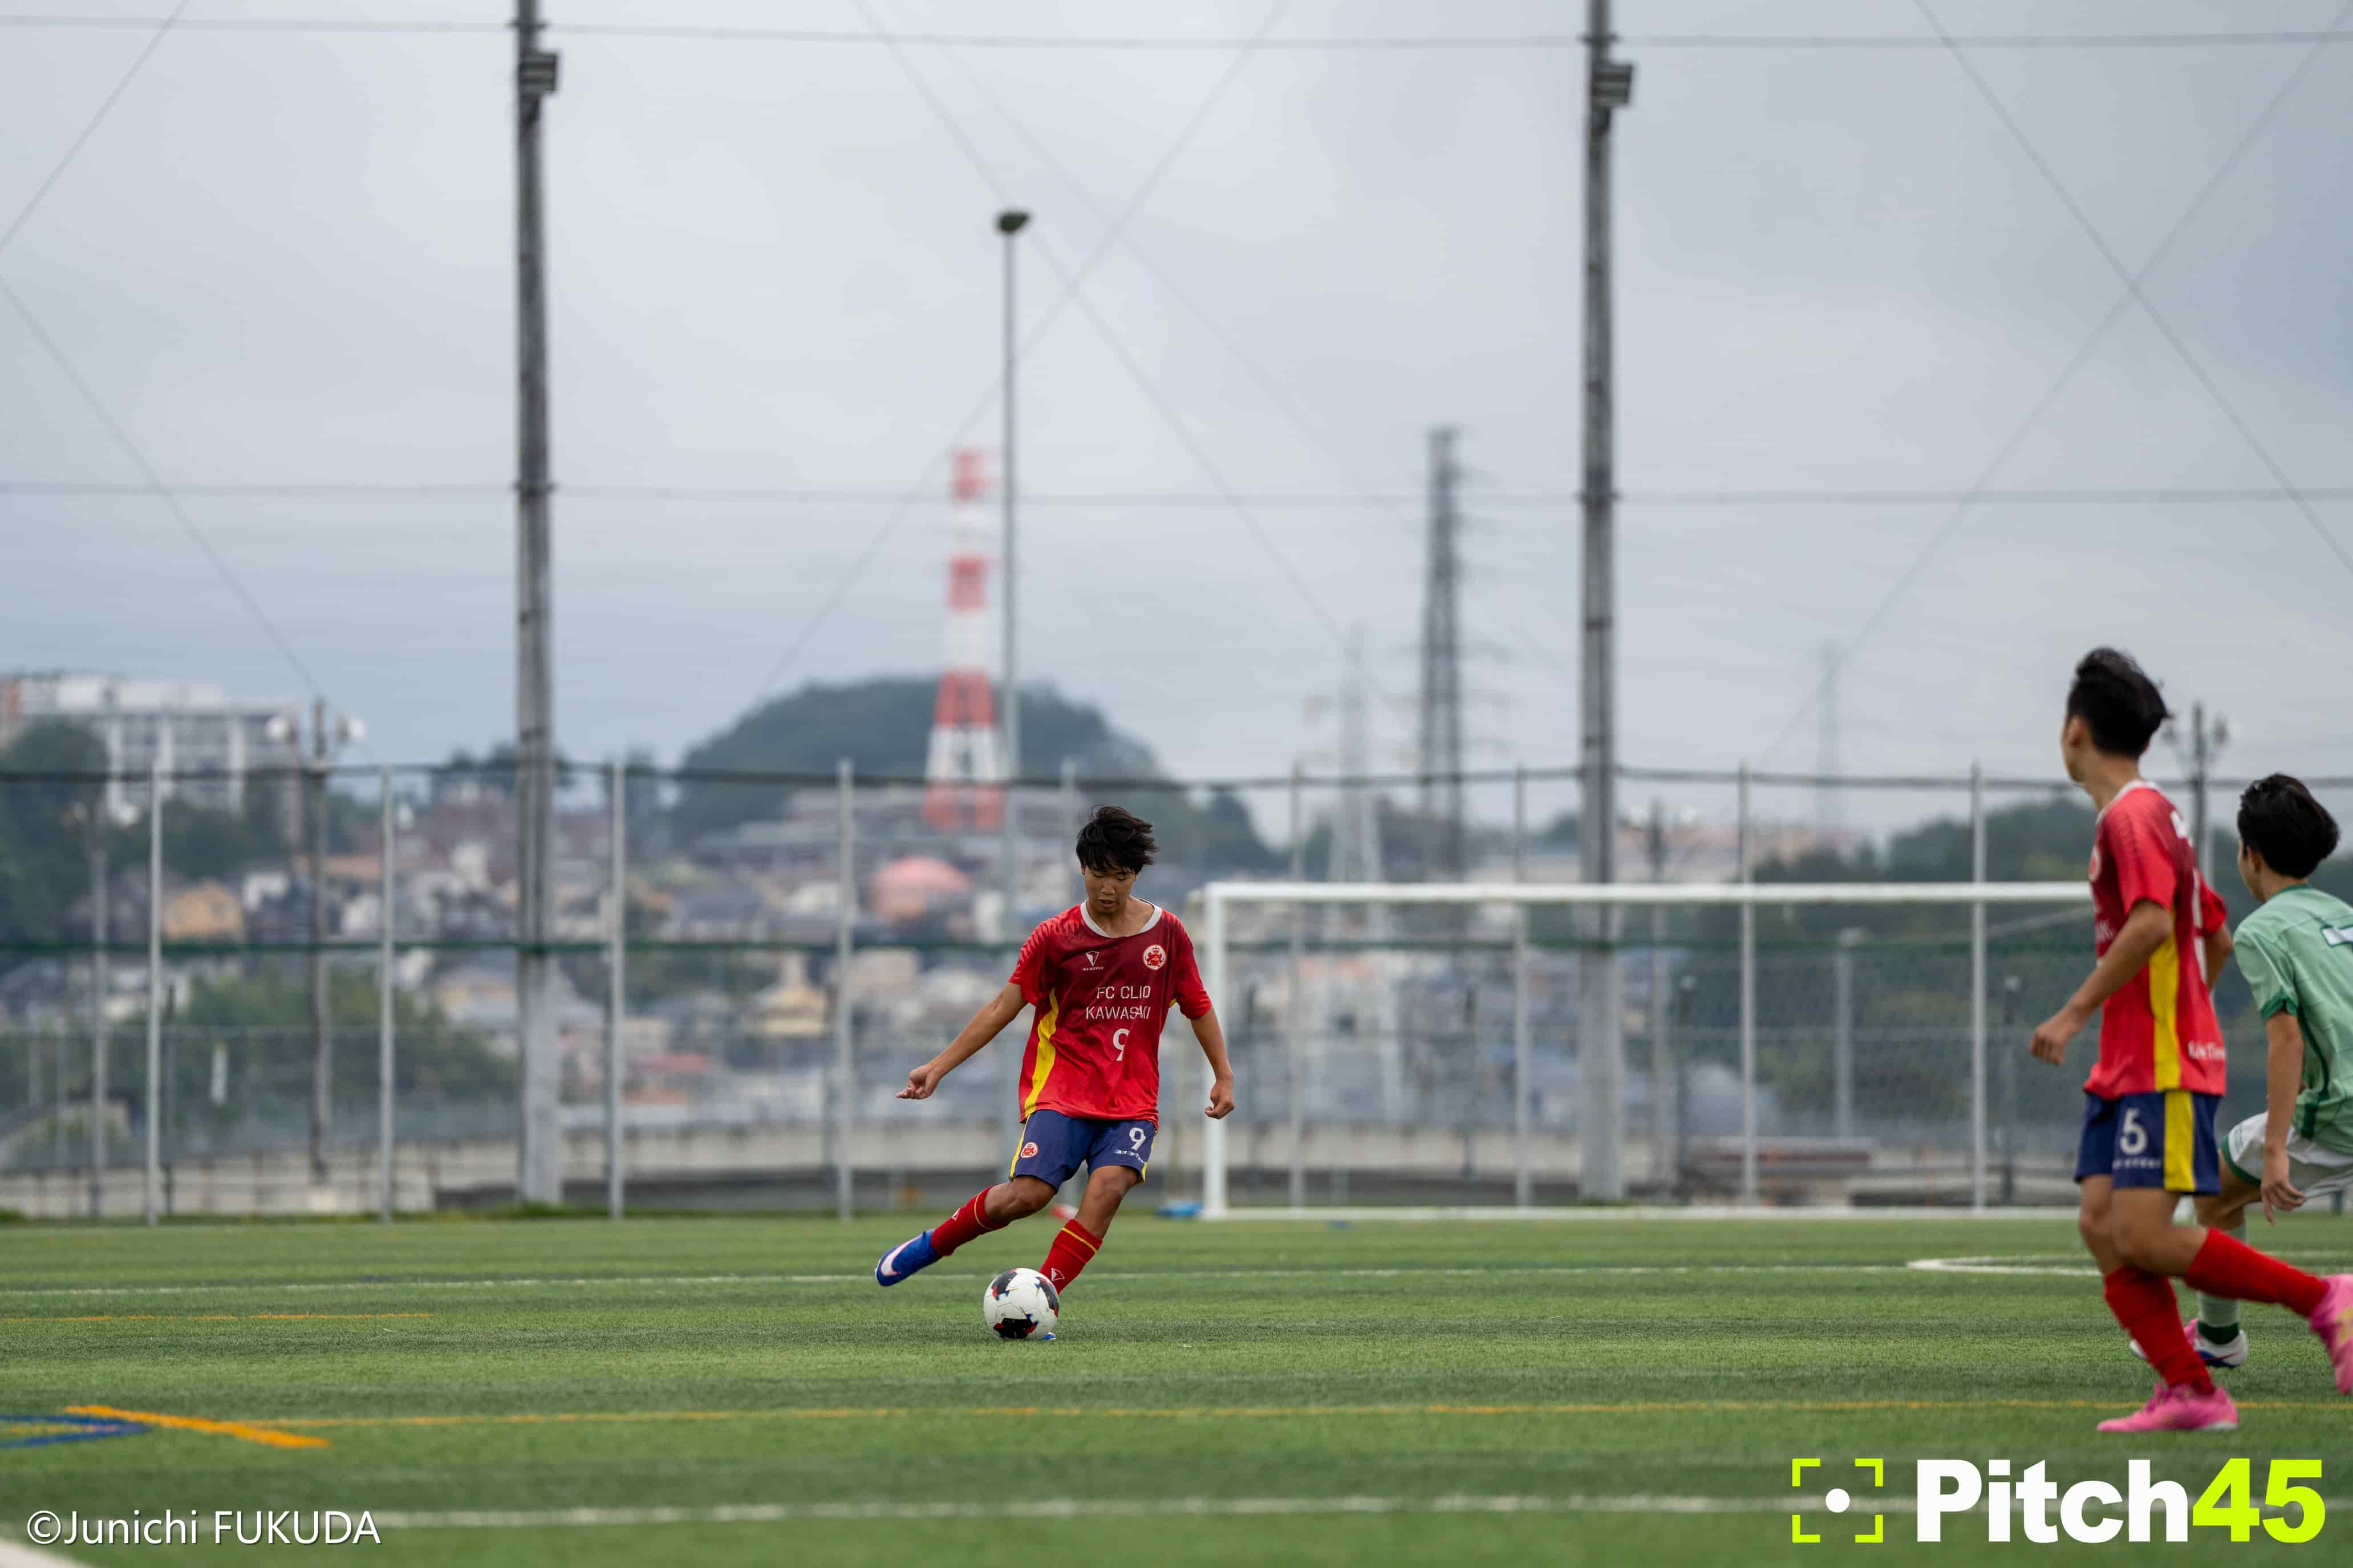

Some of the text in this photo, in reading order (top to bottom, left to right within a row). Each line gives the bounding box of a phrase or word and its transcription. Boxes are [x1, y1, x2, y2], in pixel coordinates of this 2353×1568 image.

[1097, 986, 1151, 999] FC CLIO
[1129, 1127, 1146, 1151] 9
